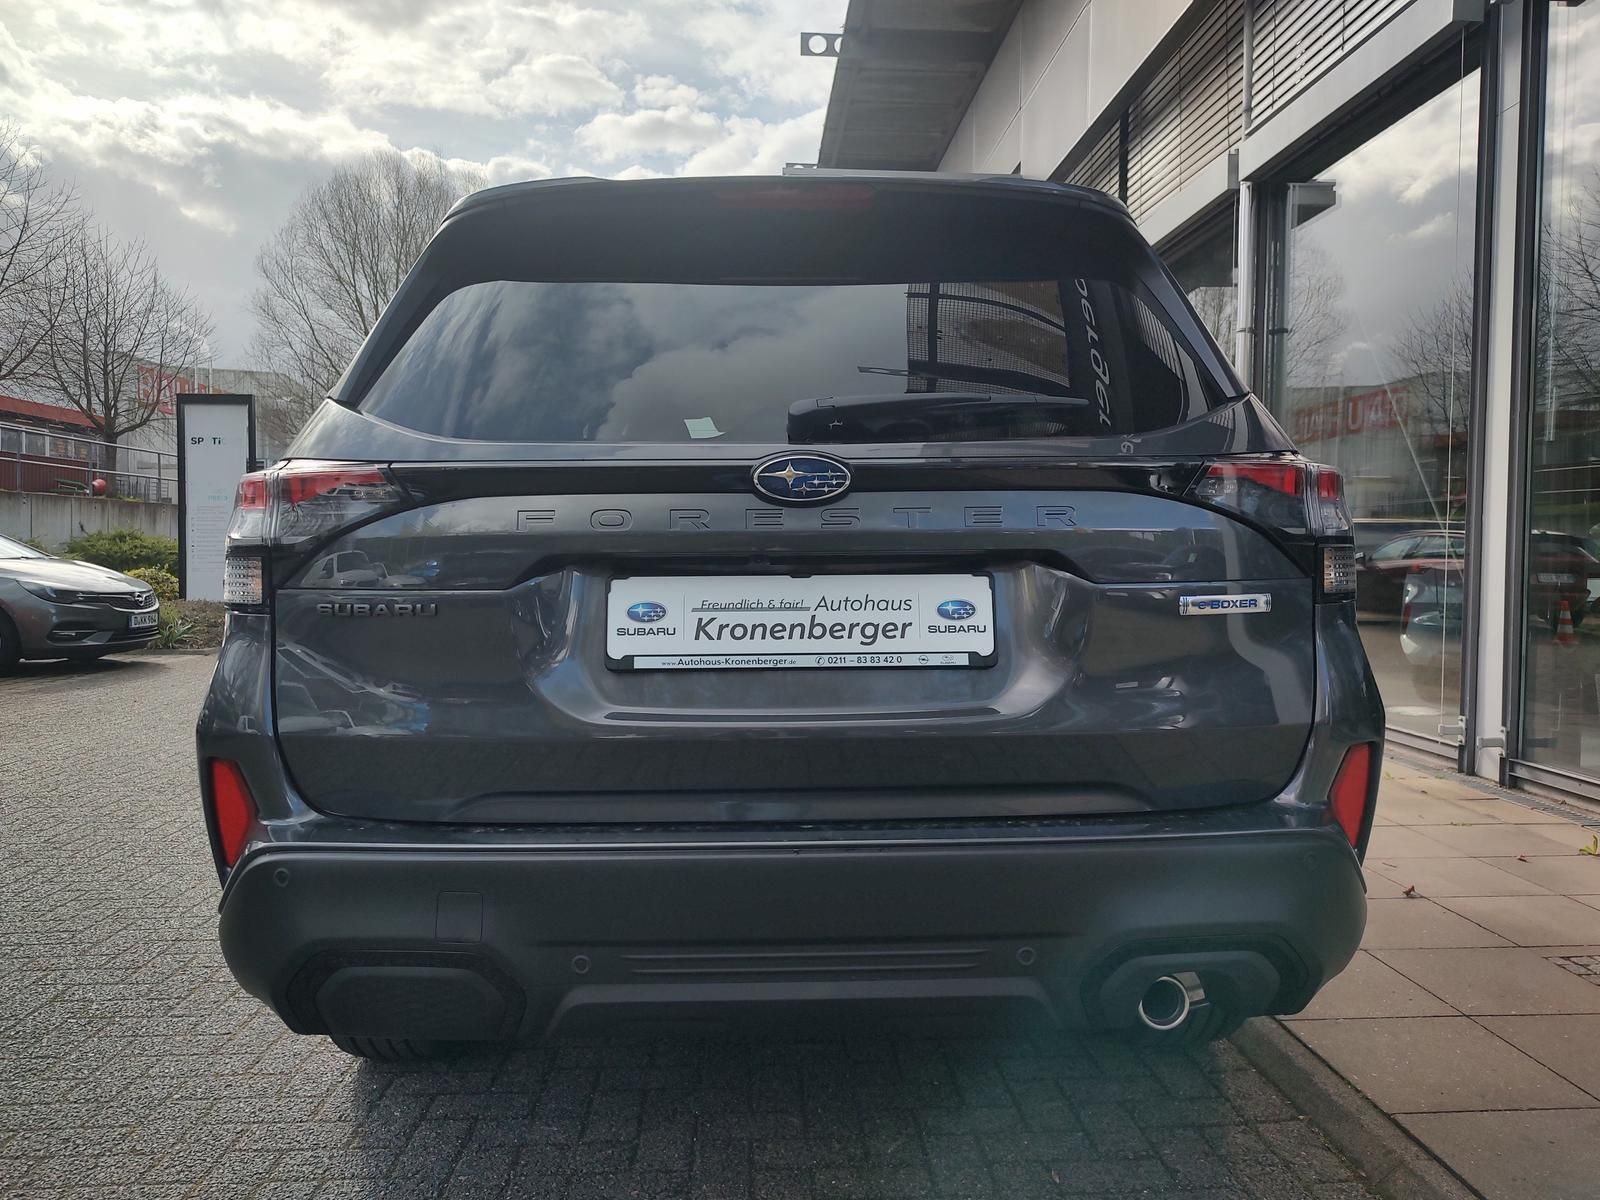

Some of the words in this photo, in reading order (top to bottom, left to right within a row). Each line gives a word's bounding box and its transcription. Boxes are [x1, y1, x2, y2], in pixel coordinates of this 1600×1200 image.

[191, 437, 204, 445] SP
[212, 437, 221, 445] Ti
[516, 506, 1078, 531] FORESTER
[700, 599, 763, 609] Freundlich
[768, 600, 777, 609] &
[777, 599, 804, 611] fair!
[814, 594, 912, 612] Autohaus
[316, 603, 438, 616] SUBARU
[616, 627, 676, 636] SUBARU
[694, 615, 913, 646] Kronenberger
[927, 624, 986, 633] SUBARU
[661, 657, 797, 667] www.Autohaus-Kronenberger.de
[827, 656, 846, 664] 0211
[856, 656, 867, 664] 83
[869, 656, 881, 664] 83
[883, 655, 894, 664] 42
[896, 655, 902, 664] 0
